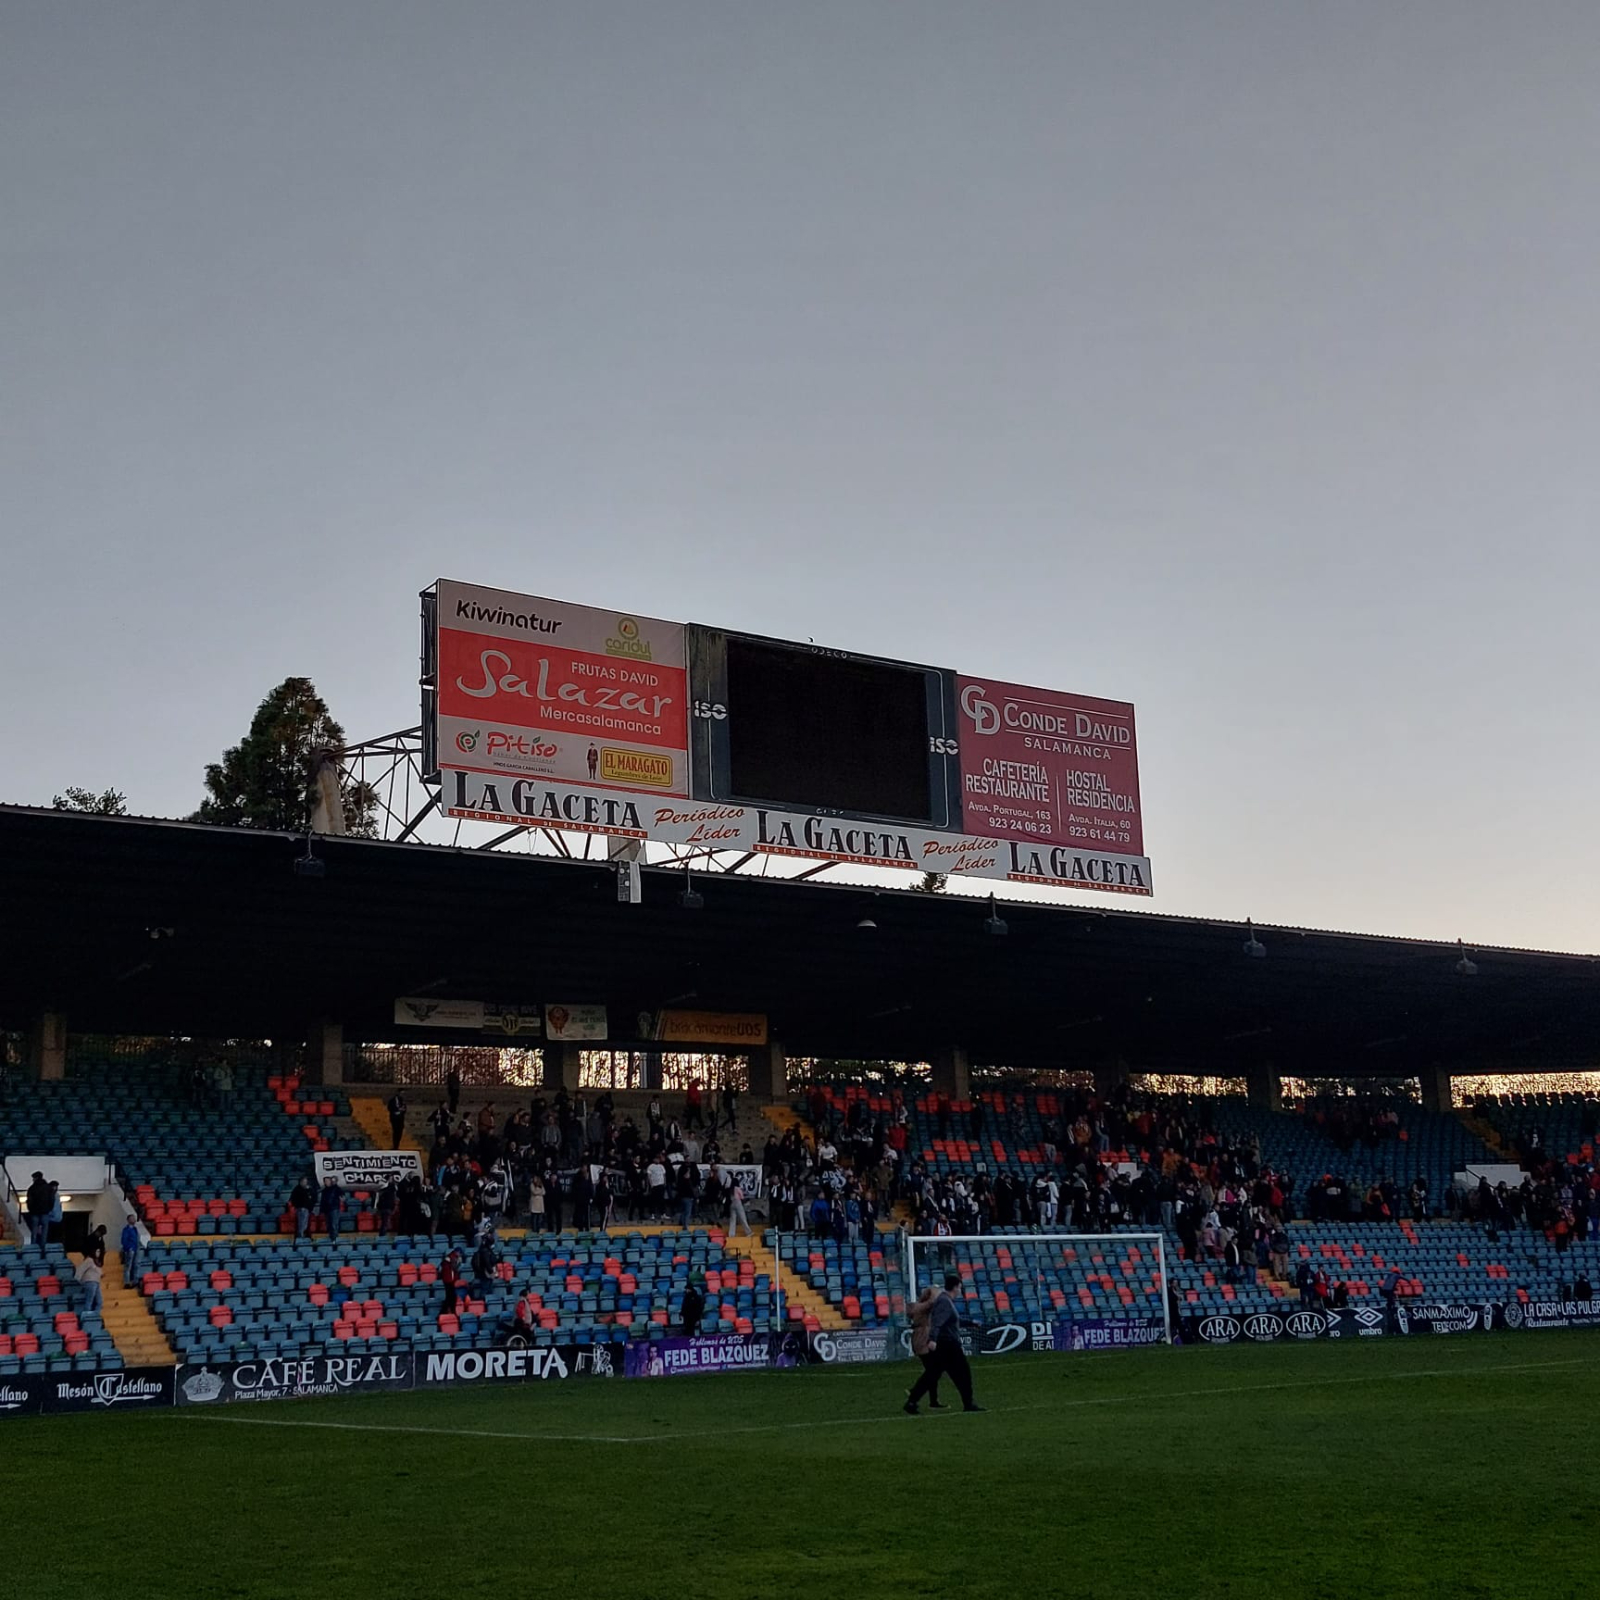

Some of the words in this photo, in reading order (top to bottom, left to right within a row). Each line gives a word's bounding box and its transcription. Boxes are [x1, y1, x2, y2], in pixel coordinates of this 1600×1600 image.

[455, 599, 562, 635] Kiwinatur
[456, 650, 672, 718] Salazar
[571, 661, 616, 680] FRUTAS
[620, 669, 659, 687] DAVID
[540, 704, 662, 736] Mercasalamanca
[486, 730, 558, 758] Pitiso
[1024, 736, 1112, 760] SALAMANCA
[605, 752, 616, 768] EL
[617, 754, 668, 776] MARAGATO
[982, 758, 1049, 785] CAFETERÍA
[965, 774, 1051, 802] RESTAURANTE
[1066, 769, 1112, 793] HOSTAL
[454, 771, 504, 813] LA
[512, 779, 643, 830] GACETA
[1066, 787, 1136, 813] RESIDENCIA
[453, 810, 532, 825] REGIONAL
[564, 822, 644, 838] SALAMANCA
[654, 806, 745, 828] Periódico
[988, 816, 1008, 828] 923
[1010, 820, 1022, 830] 24
[1025, 822, 1037, 832] 06
[1040, 823, 1052, 834] 23
[1036, 810, 1052, 820] 163
[1120, 820, 1131, 830] 60
[686, 823, 740, 843] Líder
[756, 810, 798, 848] LA
[804, 816, 914, 860] GACETA
[1068, 826, 1088, 838] 923
[1090, 828, 1101, 840] 61
[1104, 830, 1116, 841] 44
[1118, 832, 1130, 843] 79
[922, 838, 998, 858] Periódico
[950, 854, 996, 872] Líder
[1008, 842, 1045, 876] LA
[1050, 847, 1146, 887] GACETA
[323, 1156, 416, 1170] SENTIMIENTO
[1524, 1303, 1535, 1318] LA
[1536, 1302, 1558, 1318] CASA
[1560, 1301, 1577, 1316] LAS
[1084, 1328, 1112, 1344] FEDE
[1206, 1318, 1235, 1337] ARA
[1250, 1316, 1278, 1336] ARA
[1292, 1314, 1322, 1334] ARA
[1358, 1326, 1383, 1336] umbro
[664, 1348, 698, 1368] FEDE
[700, 1344, 770, 1364] BLAZQUEZ
[1032, 1340, 1044, 1350] DE
[232, 1356, 316, 1389] CAFÉ
[324, 1355, 408, 1387] REAL
[426, 1347, 569, 1382] MORETA
[56, 1382, 94, 1400] Mesón
[100, 1376, 162, 1399] Castellano
[234, 1390, 256, 1400] Plaza
[292, 1384, 338, 1396] SALAMANCA
